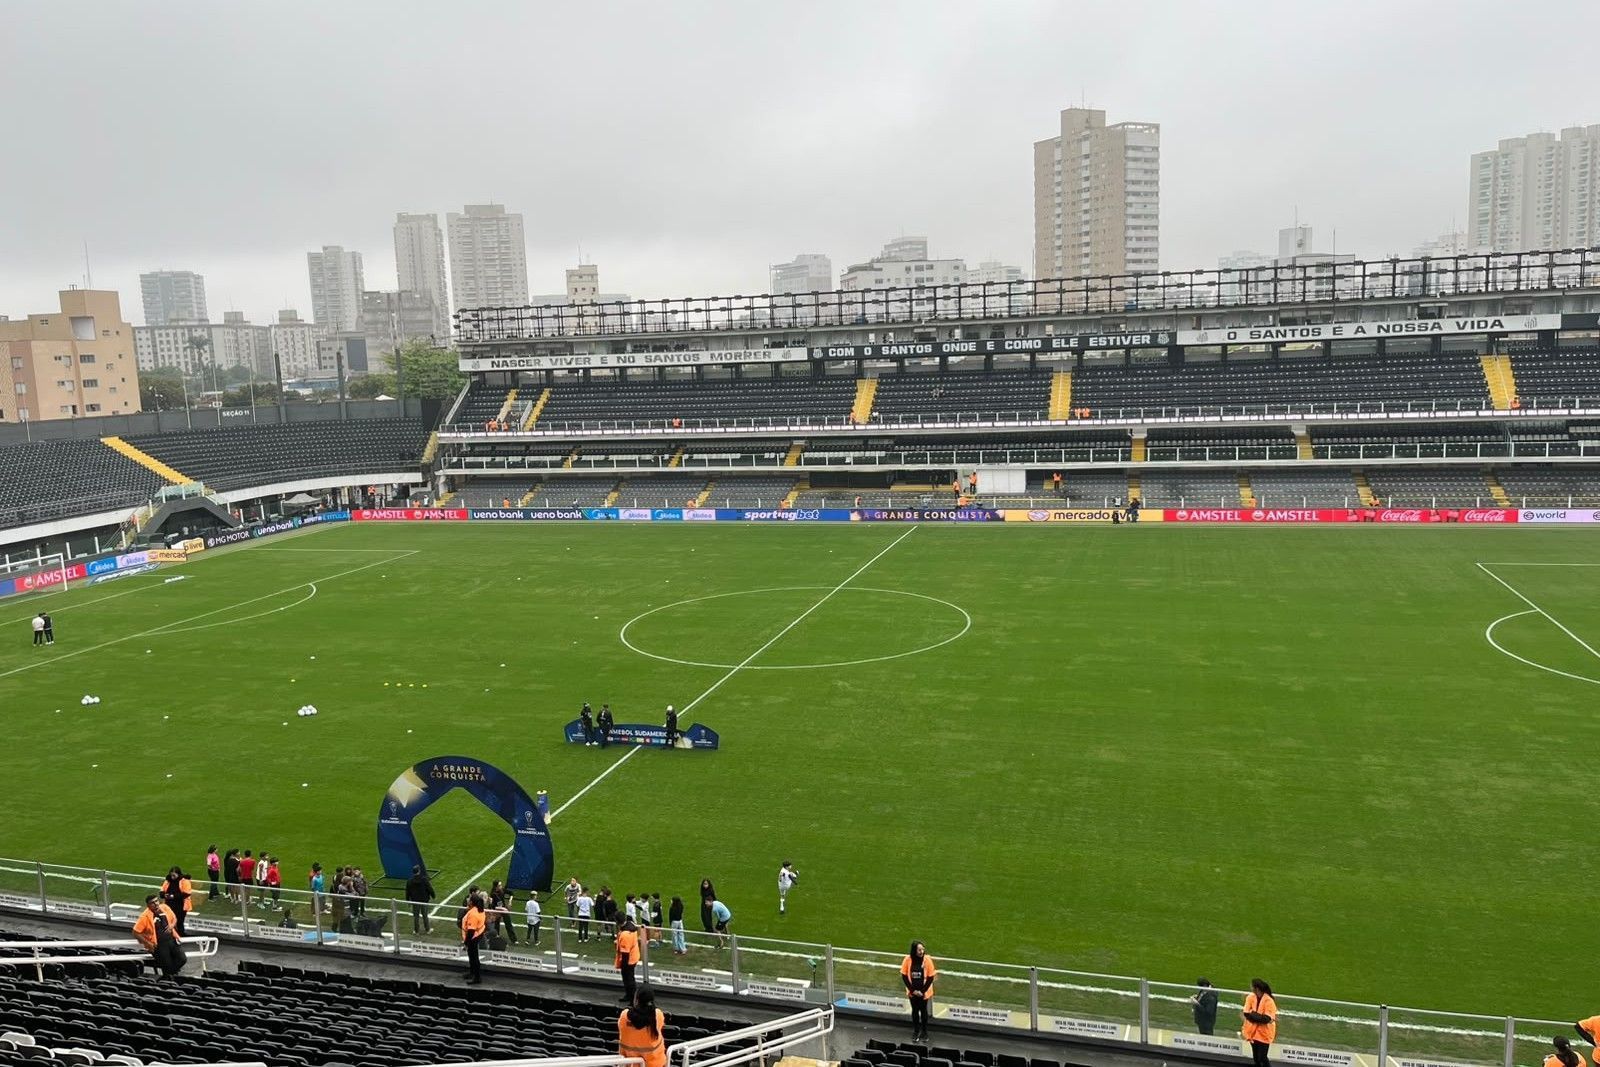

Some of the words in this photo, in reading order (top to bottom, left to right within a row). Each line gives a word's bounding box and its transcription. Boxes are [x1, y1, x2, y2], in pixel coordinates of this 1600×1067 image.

[1227, 331, 1236, 341] O
[1250, 327, 1322, 340] SANTOS
[1354, 326, 1366, 335] A
[1376, 322, 1443, 334] NOSSA
[1456, 318, 1504, 330] VIDA
[828, 346, 854, 356] COM
[864, 346, 872, 356] O
[882, 344, 932, 354] SANTOS
[942, 342, 976, 352] ONDE
[986, 340, 994, 350] E
[1004, 339, 1041, 350] COMO
[1052, 338, 1078, 348] ELE
[1089, 334, 1150, 346] ESTIVER
[550, 356, 592, 366] VIVER
[600, 356, 608, 364] E
[616, 355, 635, 364] NO
[644, 353, 700, 364] SANTOS
[710, 350, 772, 361] MORRER
[372, 510, 407, 519] AMSTEL
[498, 510, 524, 519] bank
[556, 510, 582, 519] bank
[744, 510, 820, 520] sportingbet
[924, 511, 991, 520] CONQUISTA
[1054, 510, 1110, 520] mercado
[1190, 510, 1241, 520] AMSTEL
[1266, 510, 1320, 521] AMSTEL
[1536, 511, 1566, 520] world
[257, 526, 275, 536] ueno
[276, 520, 294, 533] bank
[227, 531, 250, 542] MOTOR
[36, 567, 79, 586] AMSTEL
[443, 765, 482, 774] GRANDE
[430, 772, 486, 782] CONQUISTA
